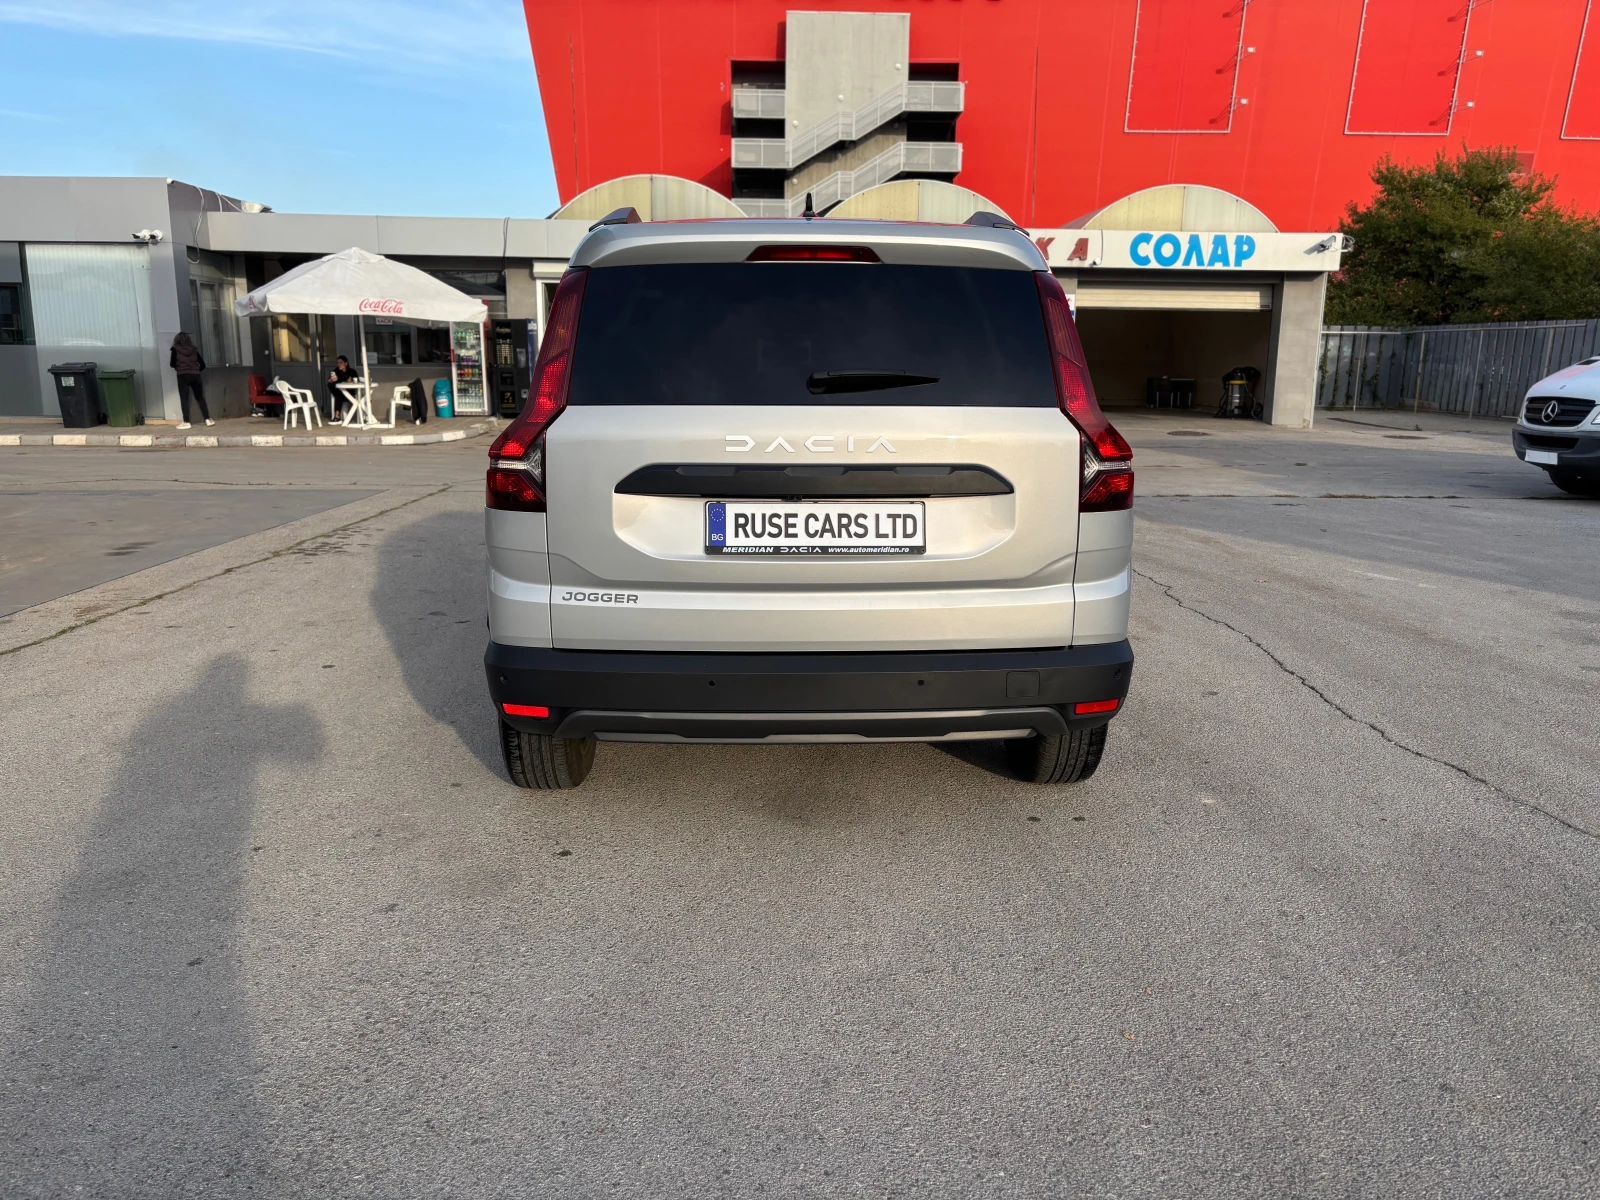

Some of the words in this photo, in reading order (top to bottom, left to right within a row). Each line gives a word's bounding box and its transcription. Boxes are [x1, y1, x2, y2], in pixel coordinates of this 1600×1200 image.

[1129, 232, 1256, 267] СОЛАР
[359, 298, 404, 314] Coca-Cola
[725, 435, 897, 453] DACIA
[734, 513, 799, 539] RUSE
[804, 512, 869, 539] CARS
[875, 513, 918, 539] LTD
[711, 533, 724, 541] BG
[562, 591, 639, 604] JOGGER
